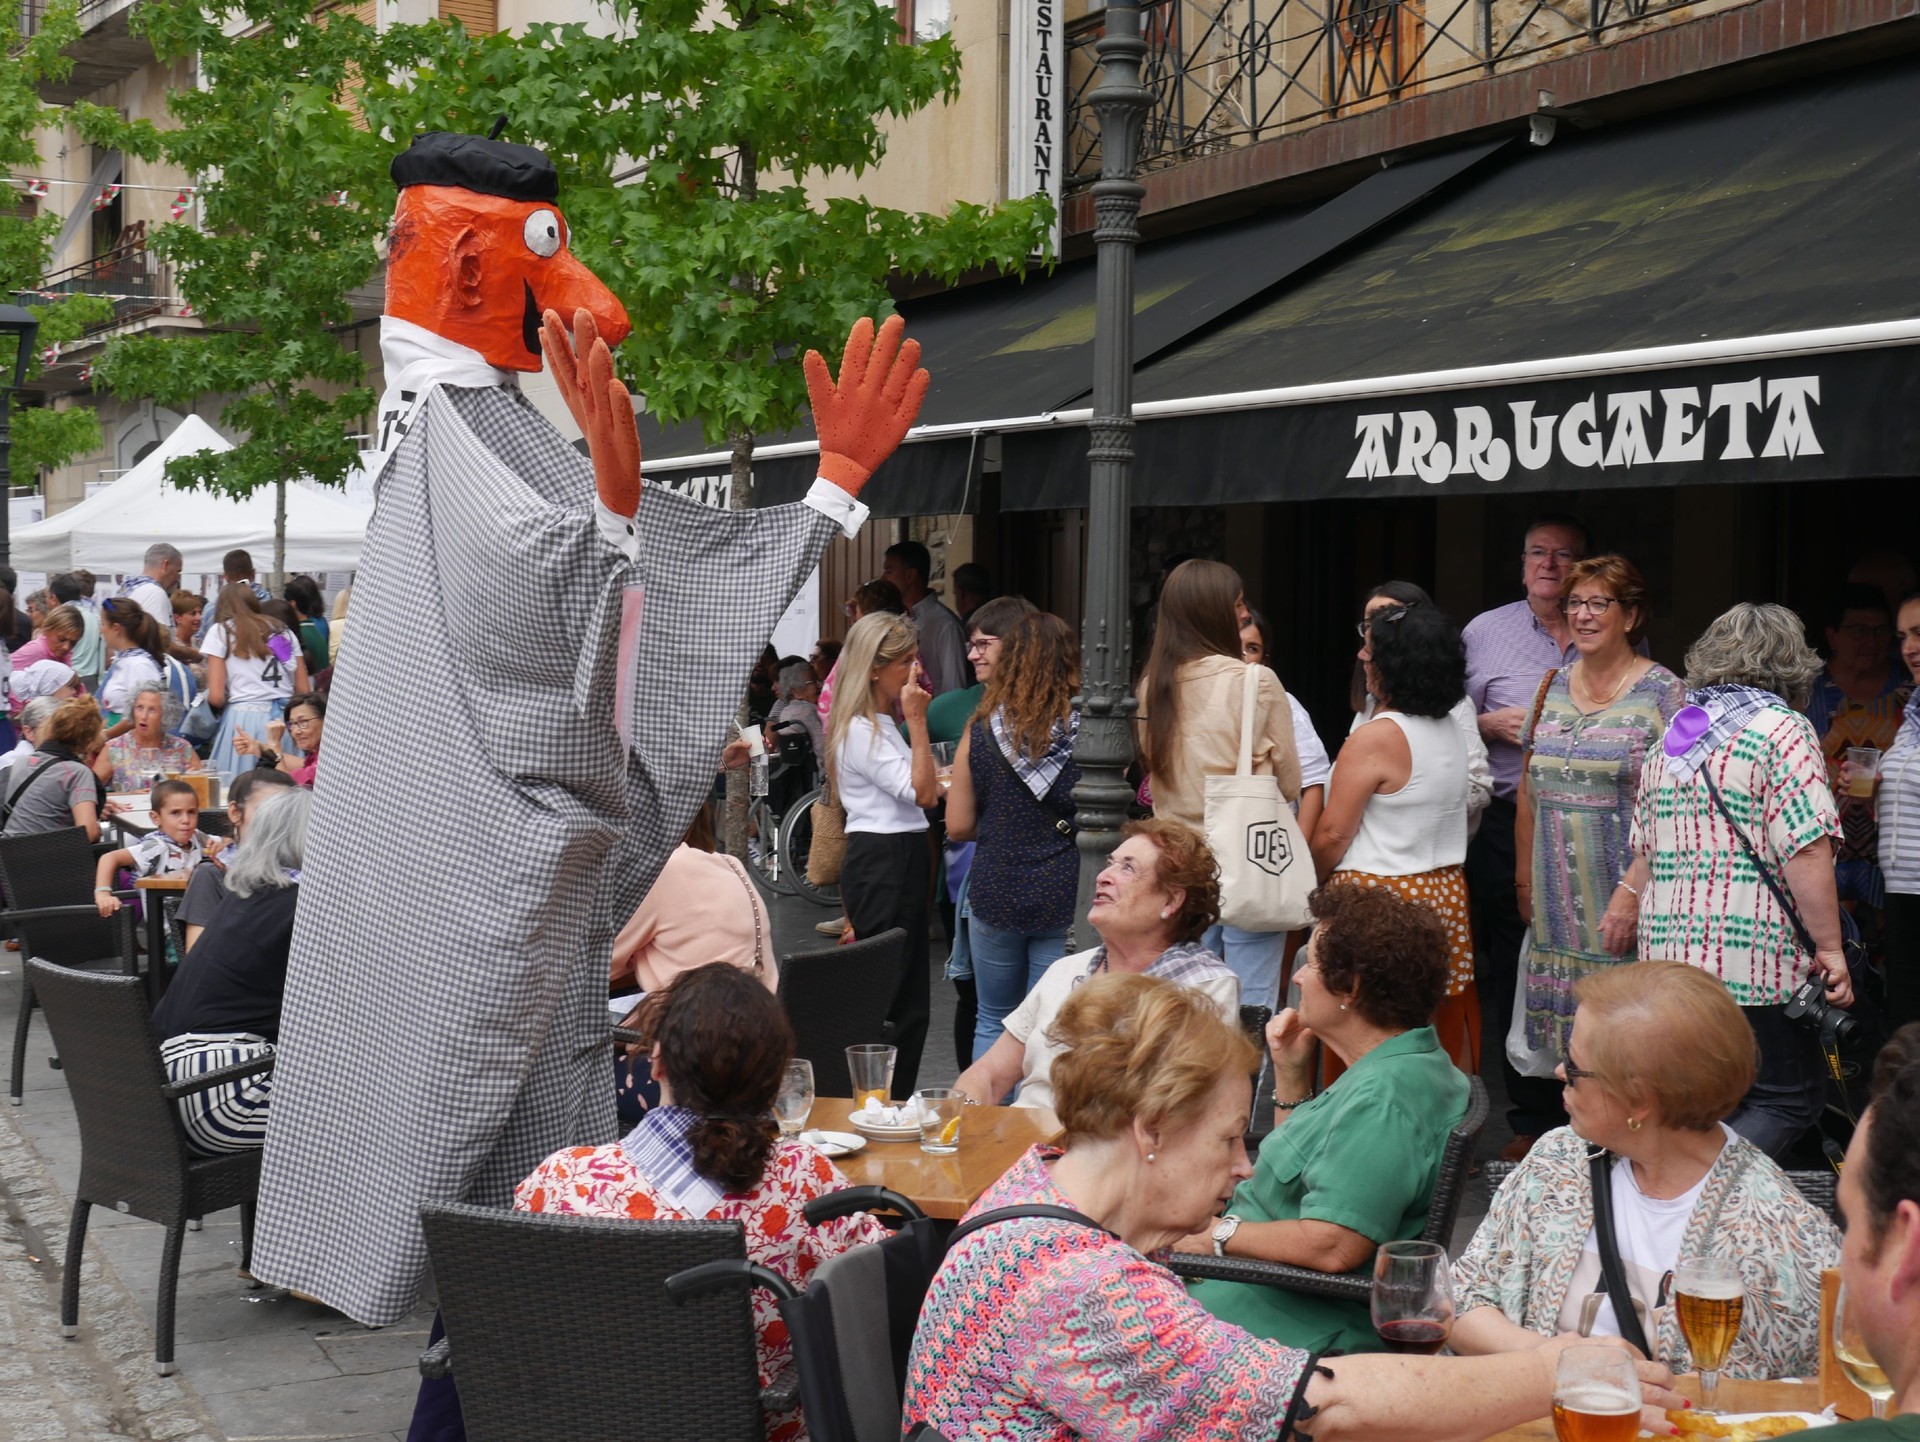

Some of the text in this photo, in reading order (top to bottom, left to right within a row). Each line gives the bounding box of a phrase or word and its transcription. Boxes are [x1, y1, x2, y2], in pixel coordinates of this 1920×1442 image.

[1034, 0, 1053, 190] STAURANT
[1345, 375, 1825, 484] ARRUGAETA
[261, 656, 283, 688] 4
